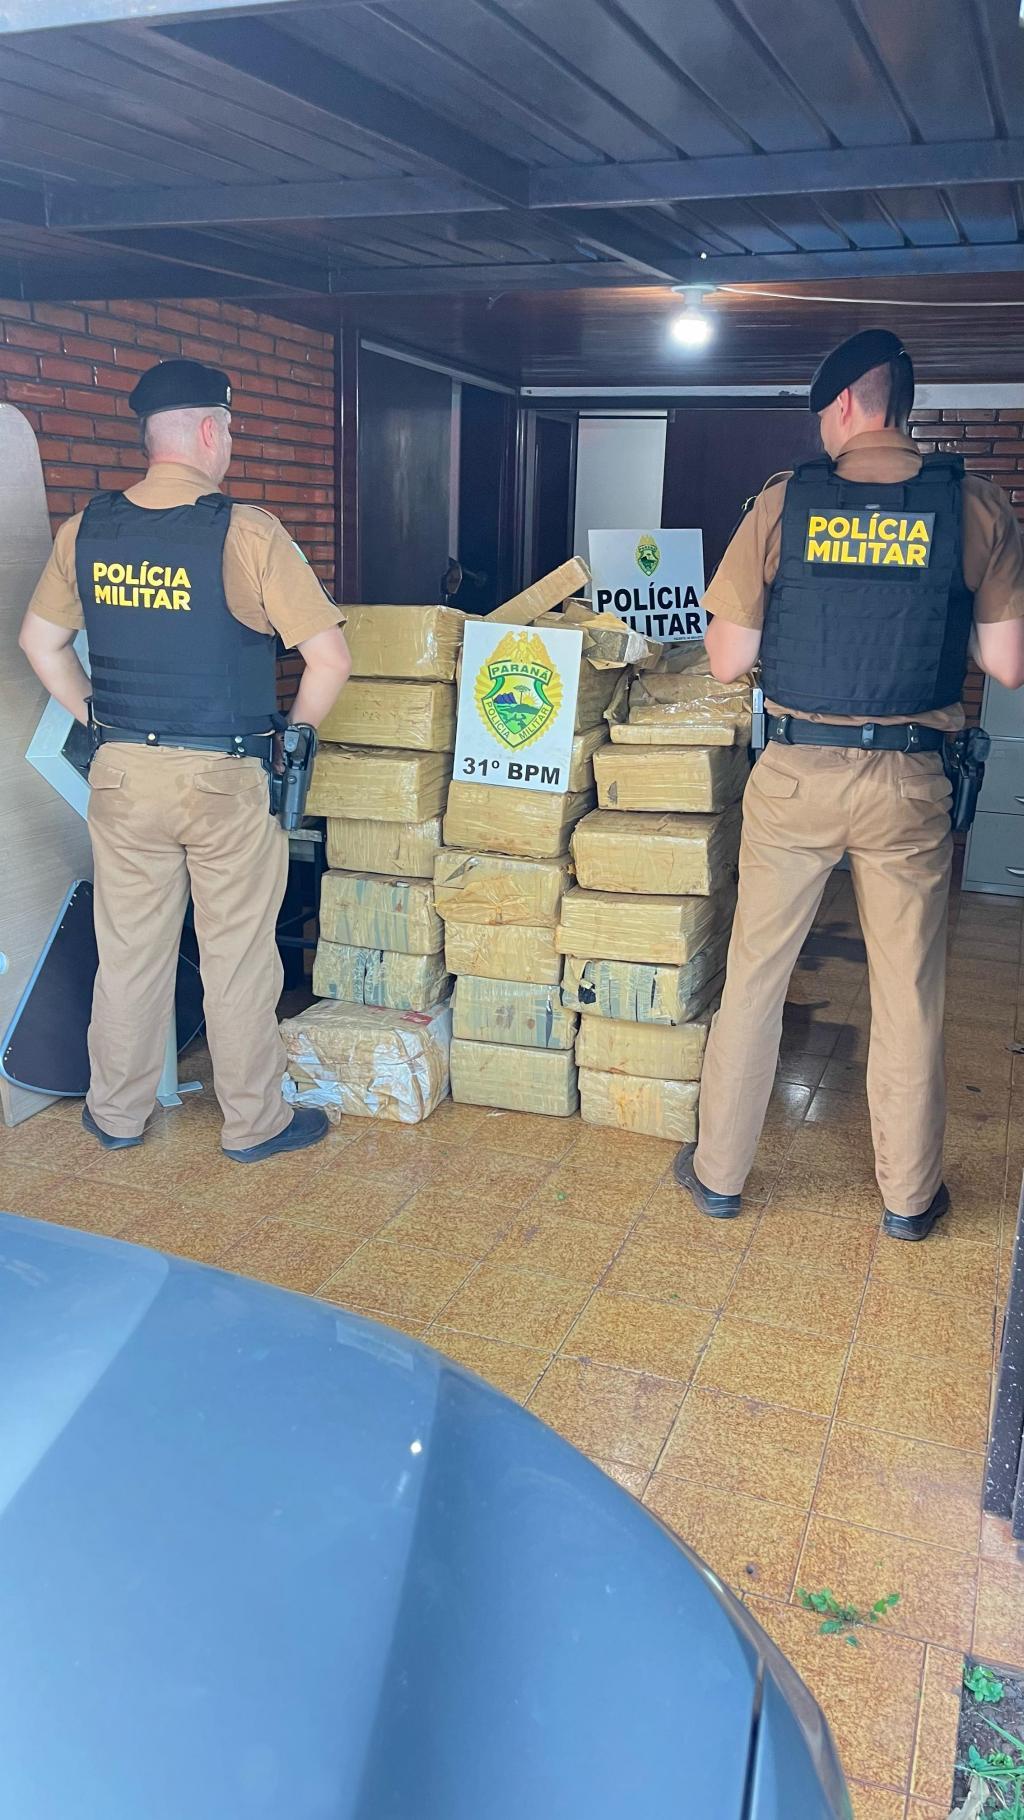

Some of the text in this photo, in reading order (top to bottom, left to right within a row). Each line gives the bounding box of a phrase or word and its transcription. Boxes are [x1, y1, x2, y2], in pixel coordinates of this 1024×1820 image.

[808, 512, 930, 542] POLÍCIA
[807, 540, 927, 566] MILITAR
[93, 560, 192, 588] POLÍCIA
[94, 584, 191, 611] MILITAR
[597, 582, 700, 613] POLÍCIA
[617, 612, 703, 638] LITAR
[491, 664, 549, 680] PARANÁ
[518, 707, 549, 740] MILITAR
[507, 762, 560, 785] BPM
